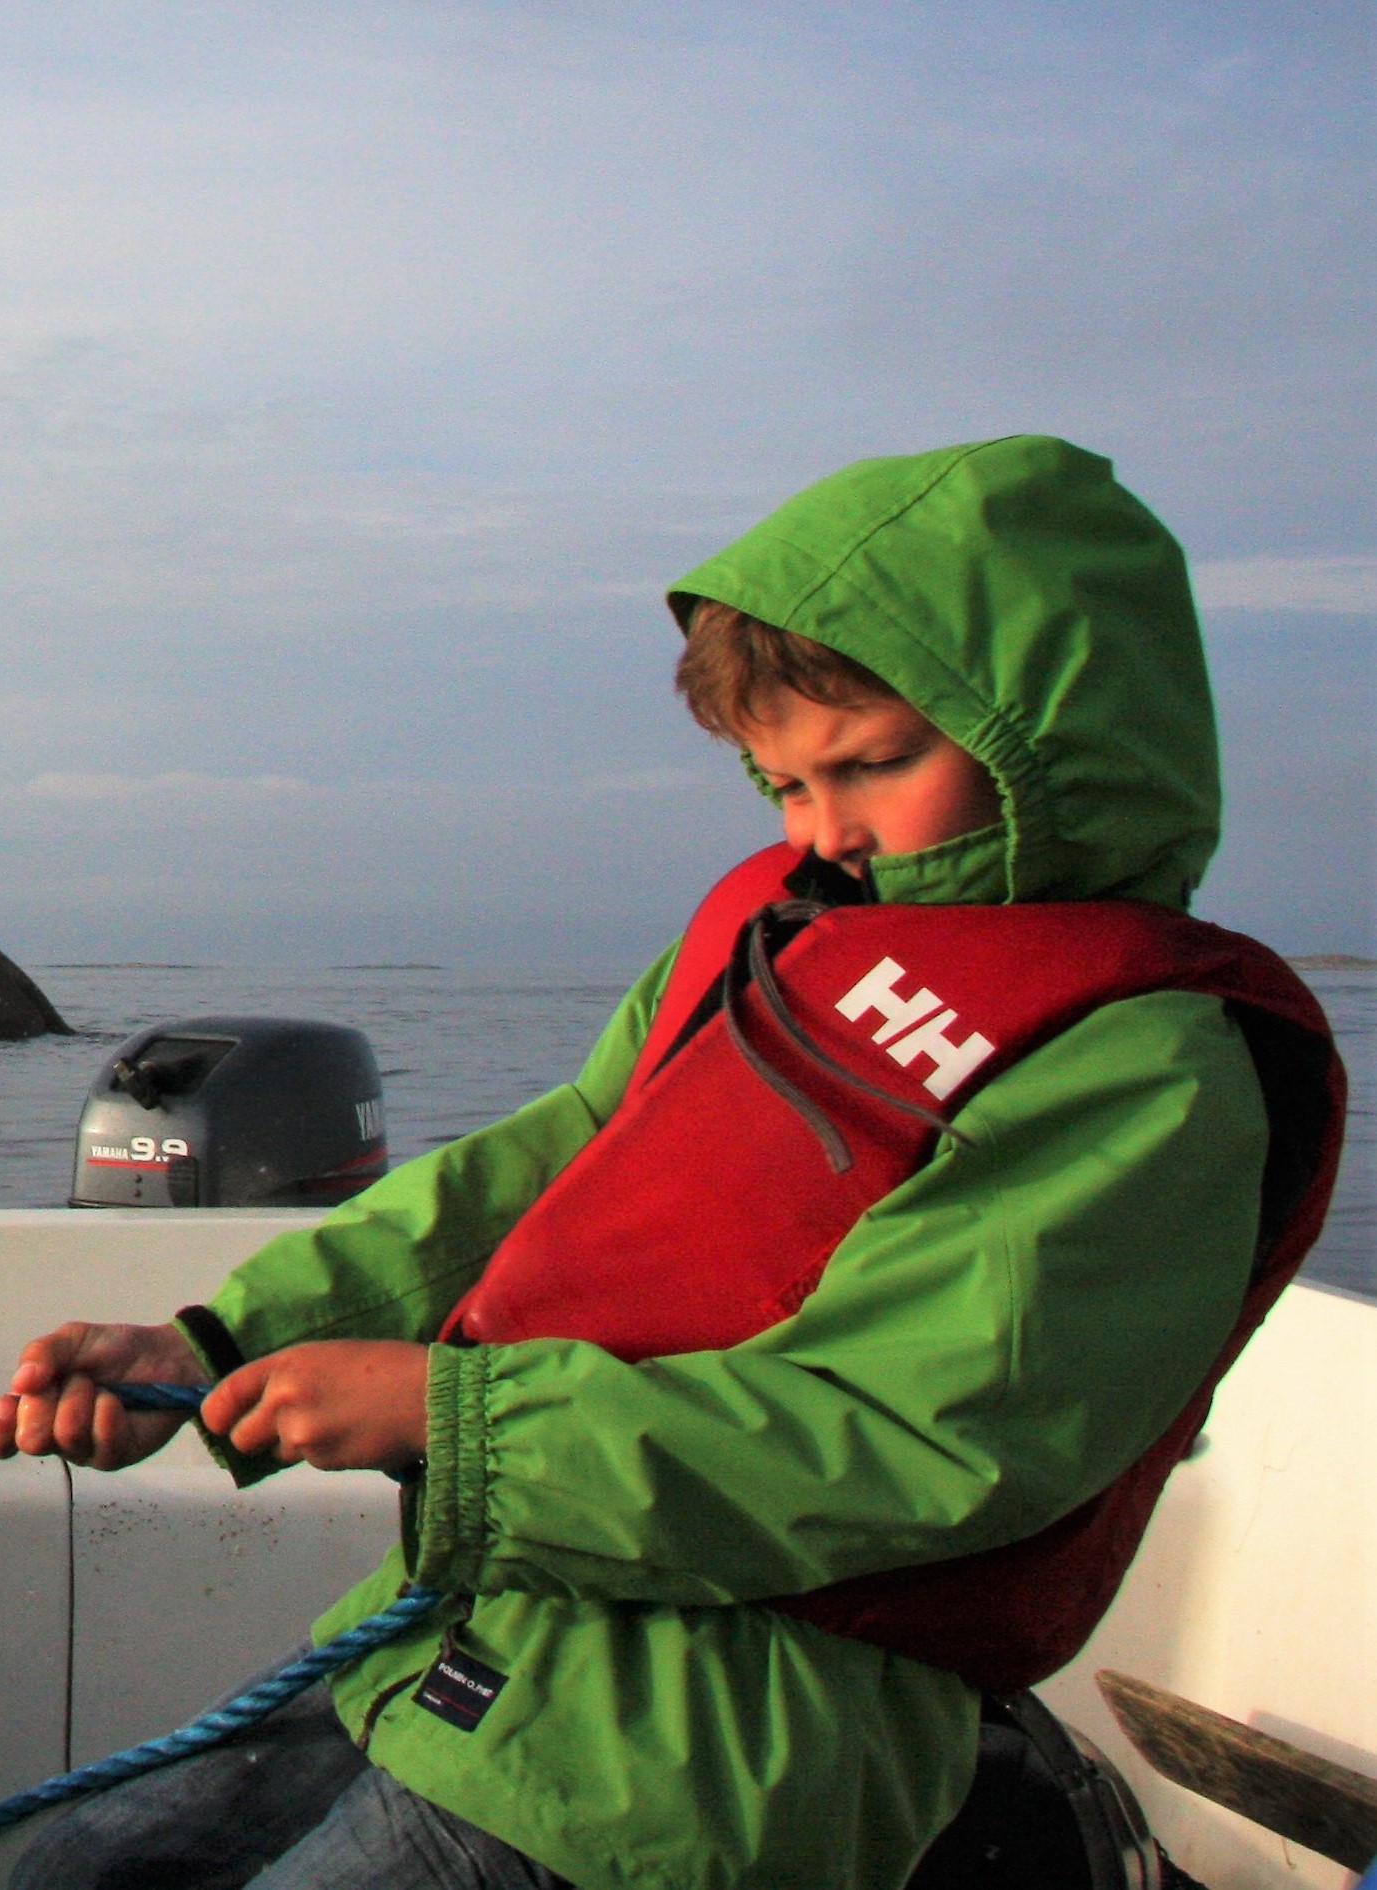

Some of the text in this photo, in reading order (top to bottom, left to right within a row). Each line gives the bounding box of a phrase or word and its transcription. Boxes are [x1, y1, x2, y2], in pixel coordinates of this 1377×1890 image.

[834, 956, 995, 1101] HH
[90, 1136, 189, 1162] YAMAHA 9.9
